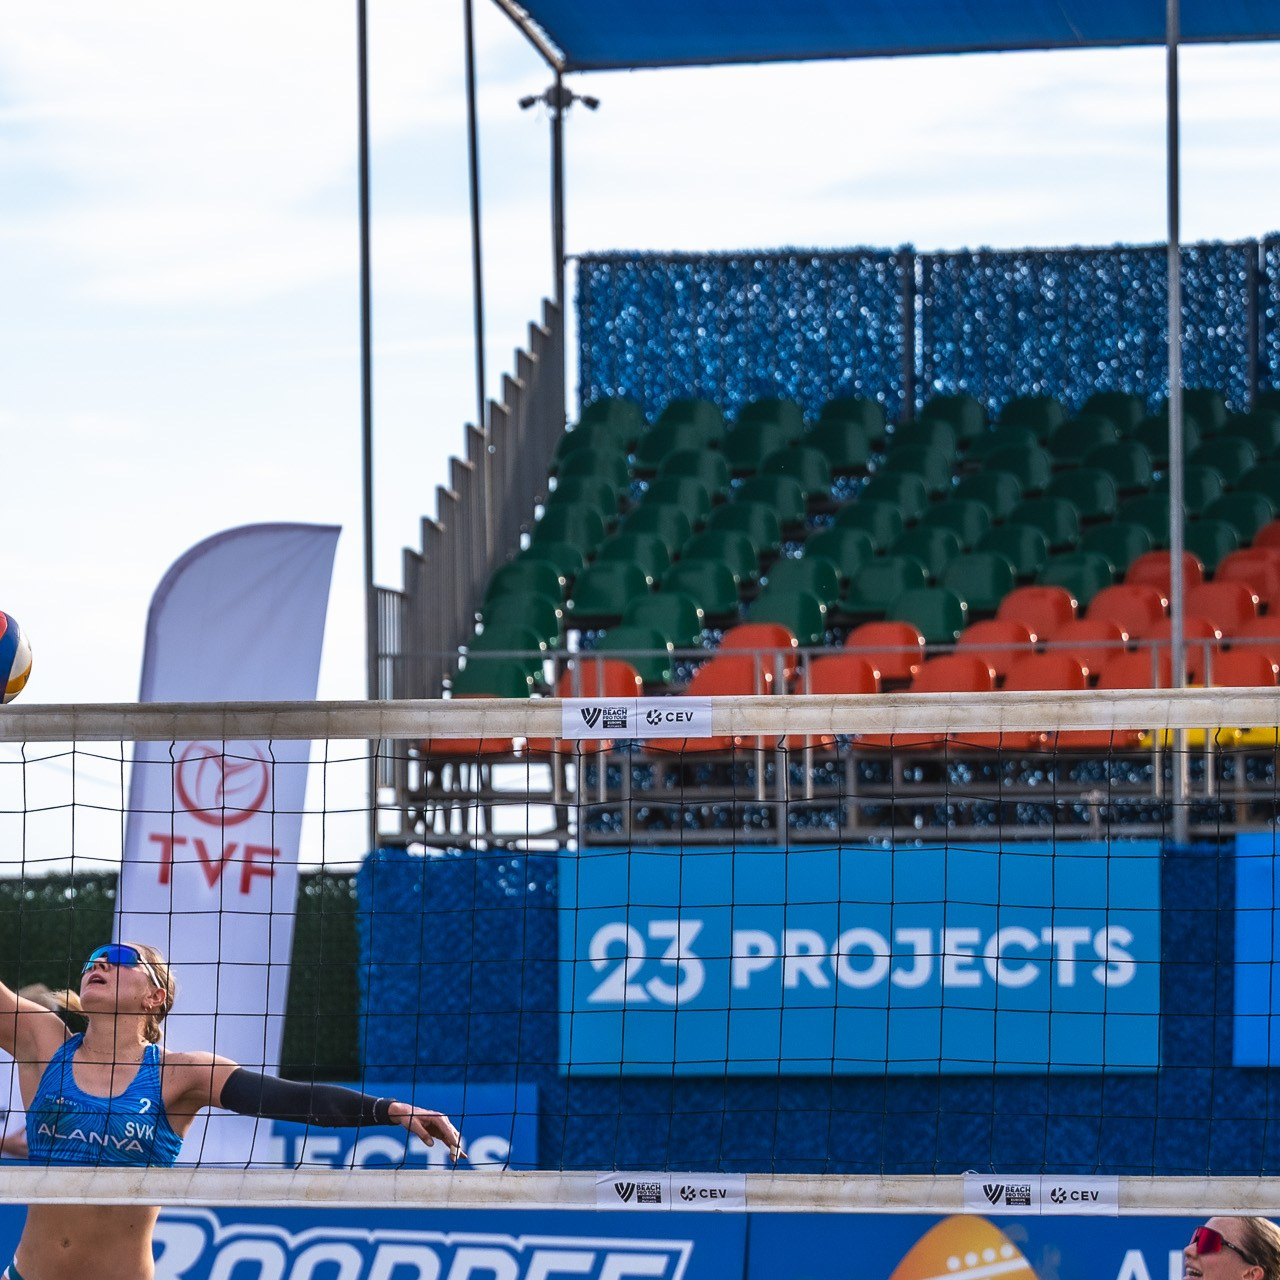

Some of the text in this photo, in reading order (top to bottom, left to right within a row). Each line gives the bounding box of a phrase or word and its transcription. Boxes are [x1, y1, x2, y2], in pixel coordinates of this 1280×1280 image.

[665, 712, 693, 722] CEV
[148, 832, 281, 895] TVF
[586, 918, 1137, 1005] 23 PROJECTS
[37, 1123, 144, 1153] ALANYA
[124, 1121, 155, 1140] SVK
[699, 1189, 727, 1198] CEV
[1070, 1191, 1099, 1201] CEV
